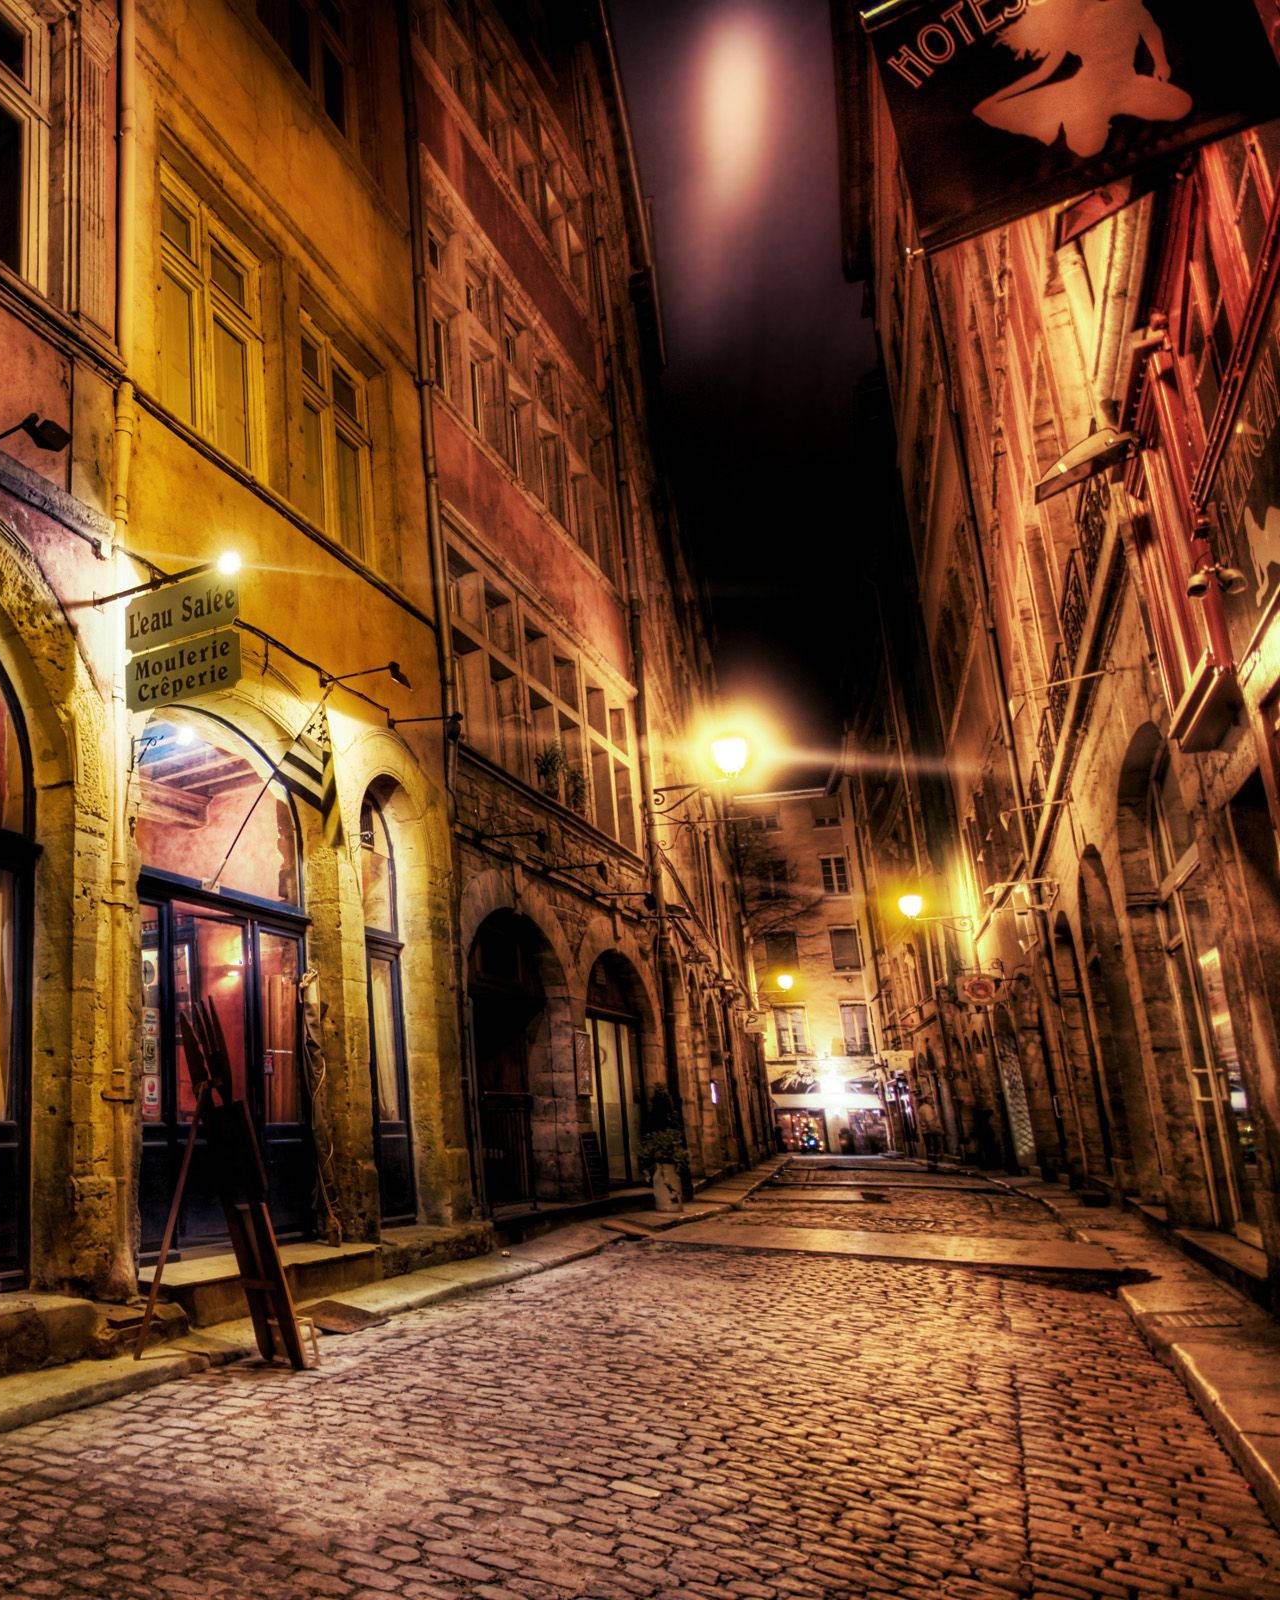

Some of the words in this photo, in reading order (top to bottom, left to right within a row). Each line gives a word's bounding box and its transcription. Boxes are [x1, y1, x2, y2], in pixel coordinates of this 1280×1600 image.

[129, 608, 173, 639] L'eau
[181, 585, 235, 622] Salée
[135, 640, 230, 681] Moulerie
[138, 665, 229, 702] Crêperie
